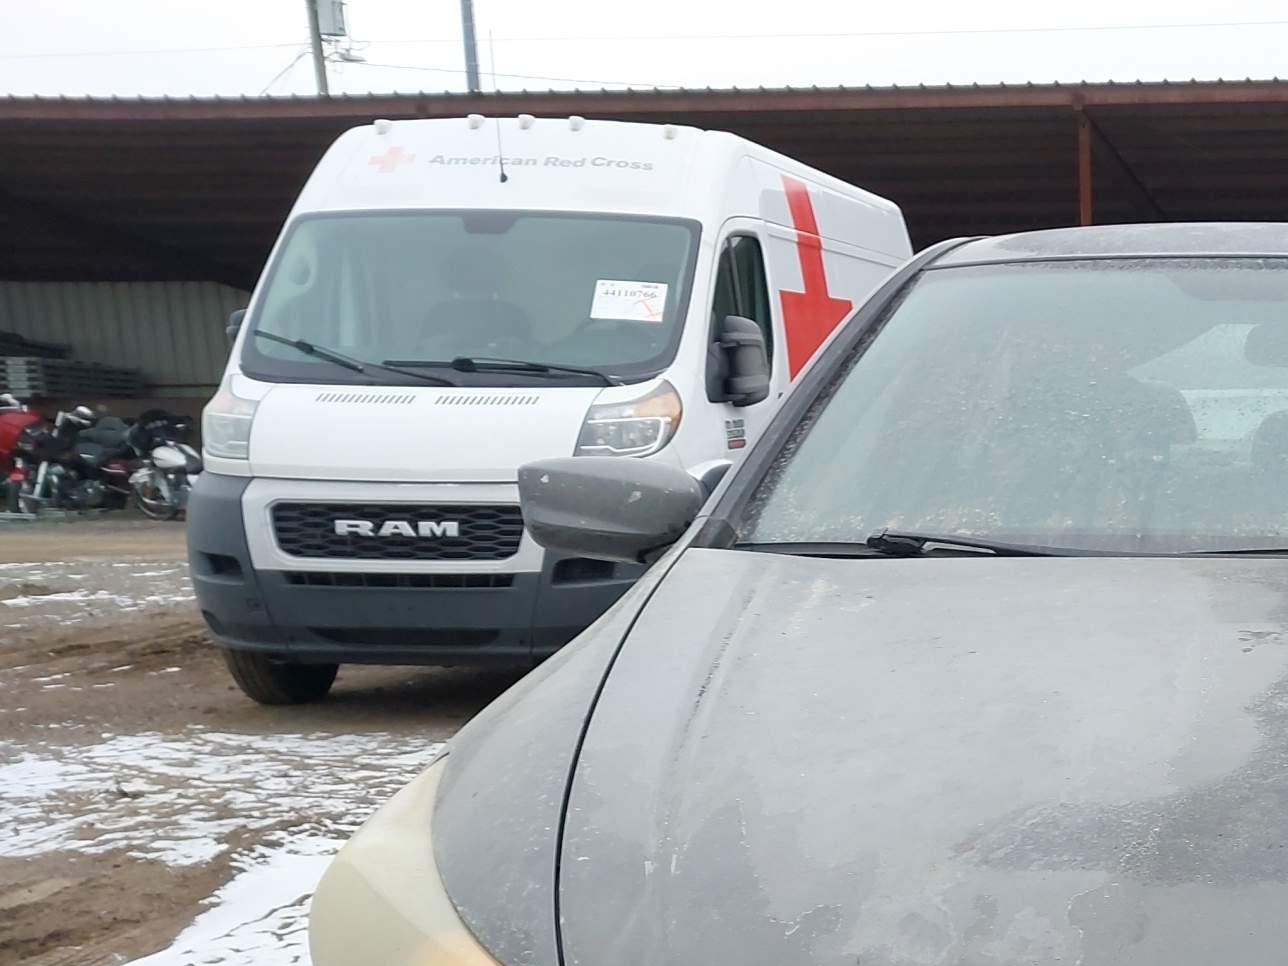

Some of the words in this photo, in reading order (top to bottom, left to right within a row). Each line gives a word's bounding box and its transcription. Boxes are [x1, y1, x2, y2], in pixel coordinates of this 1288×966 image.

[429, 154, 537, 167] American
[543, 156, 587, 167] Red
[590, 156, 654, 170] Cross
[334, 520, 459, 537] RAM
